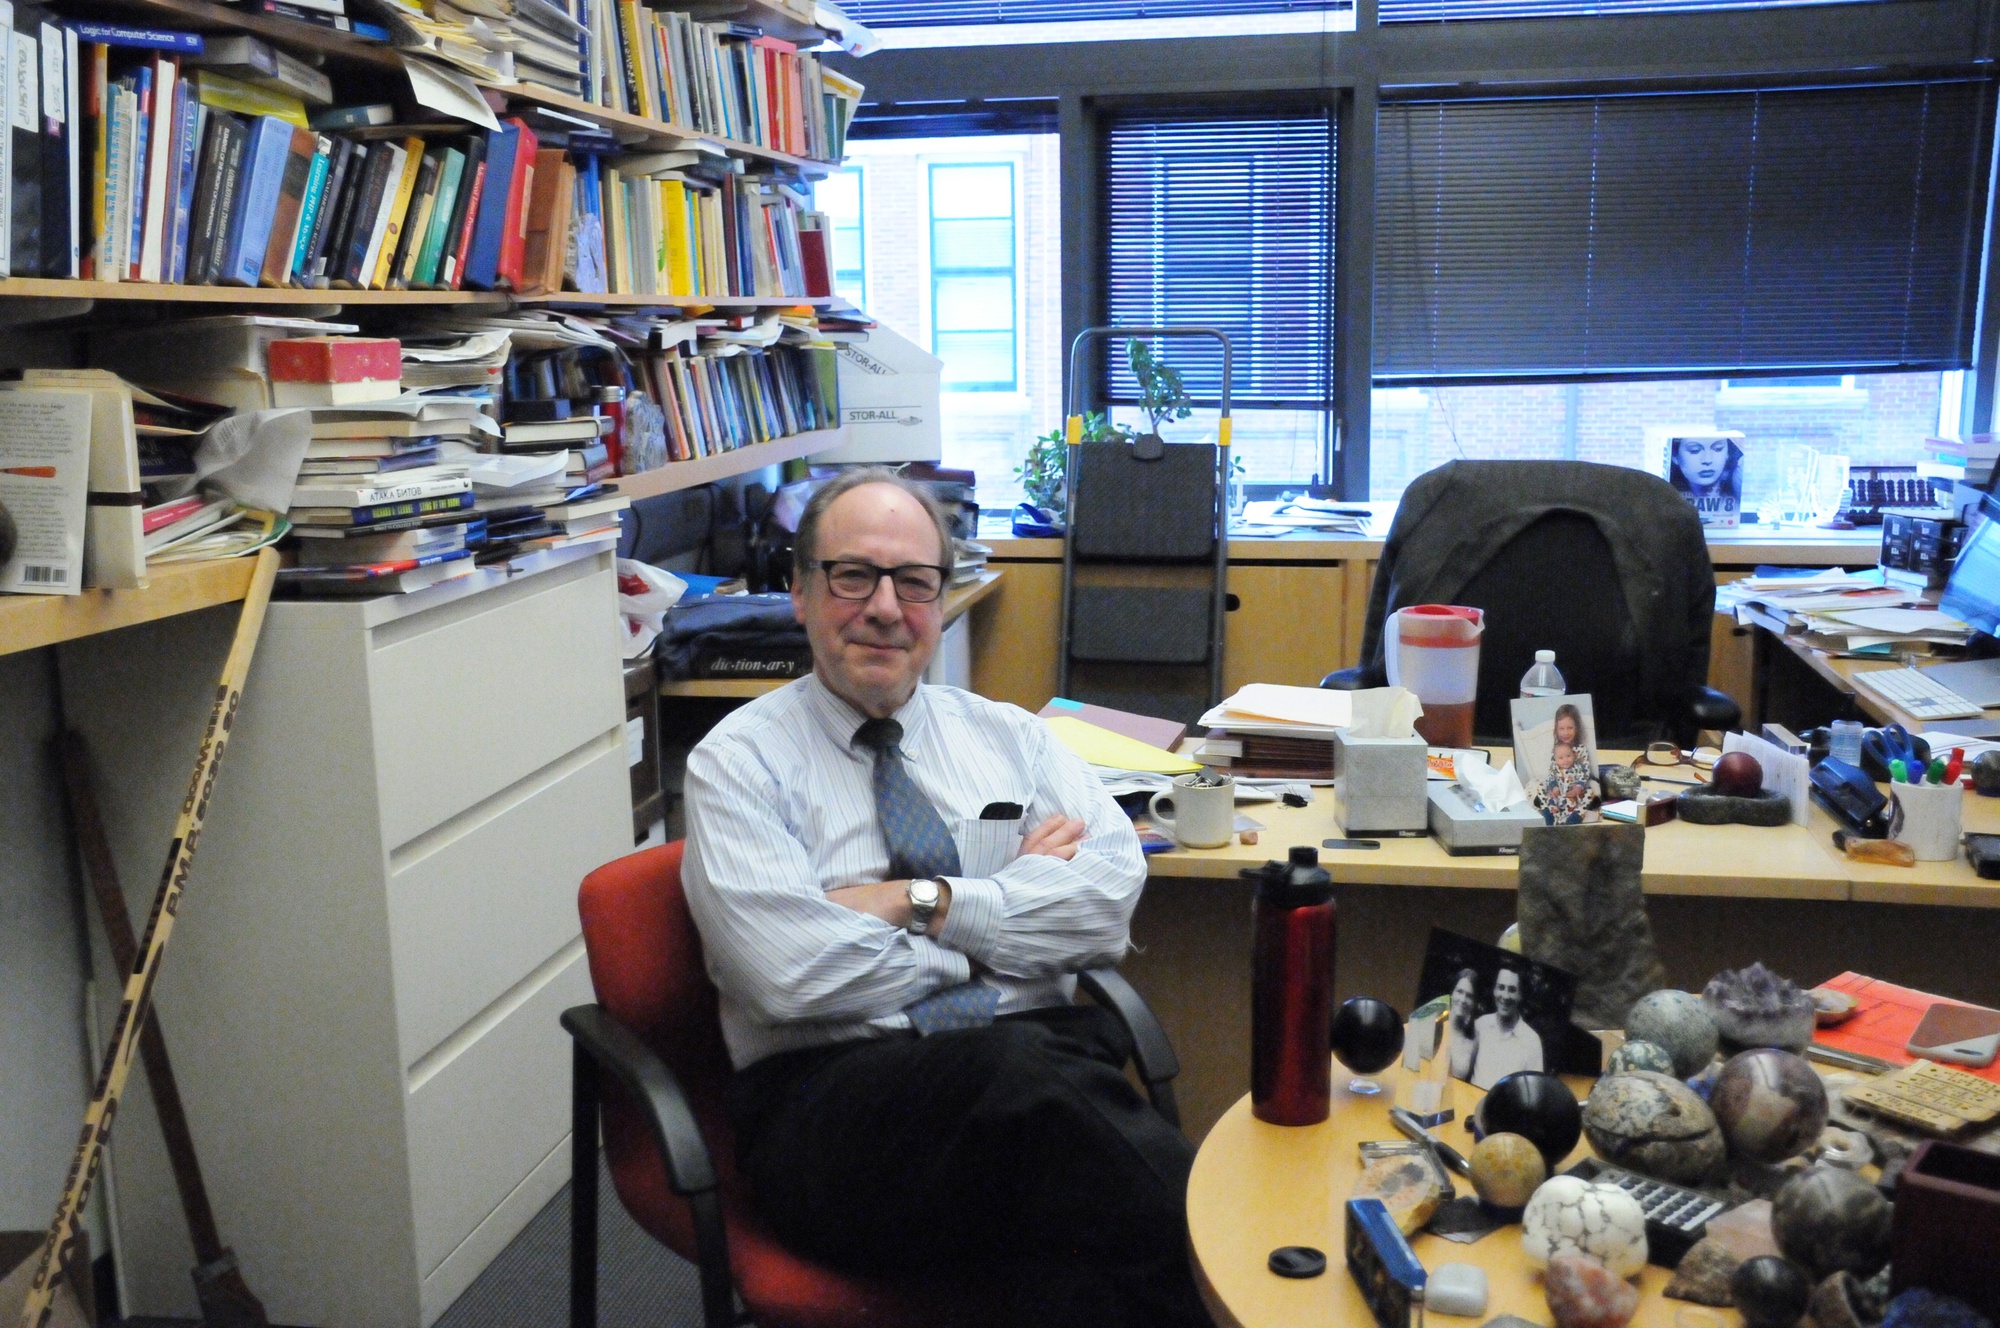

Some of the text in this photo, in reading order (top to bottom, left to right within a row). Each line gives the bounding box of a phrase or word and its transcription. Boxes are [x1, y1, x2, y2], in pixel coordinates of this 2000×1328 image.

[80, 25, 101, 38] Logic
[101, 27, 111, 35] for
[111, 27, 147, 42] Computer
[147, 31, 175, 43] Science
[183, 100, 195, 164] CAYMAN
[219, 127, 229, 152] ELEMENTS
[218, 152, 225, 162] OF
[213, 170, 222, 190] THEORY
[309, 157, 325, 193] Learning
[211, 190, 218, 199] OF
[306, 194, 317, 213] PHP
[204, 198, 216, 238] COMPUTATION
[306, 173, 334, 260] UNAUTHORIZED ACCESS
[459, 164, 485, 261] Advanced Linux Programming
[298, 222, 310, 251] MySQL
[849, 410, 897, 421] STOR-ALL
[369, 488, 395, 502] АТАКА
[397, 487, 422, 499] БИТОВ
[1724, 498, 1734, 512] 8
[181, 684, 229, 818] SHER-WOOD
[165, 828, 201, 918] P.M.P.
